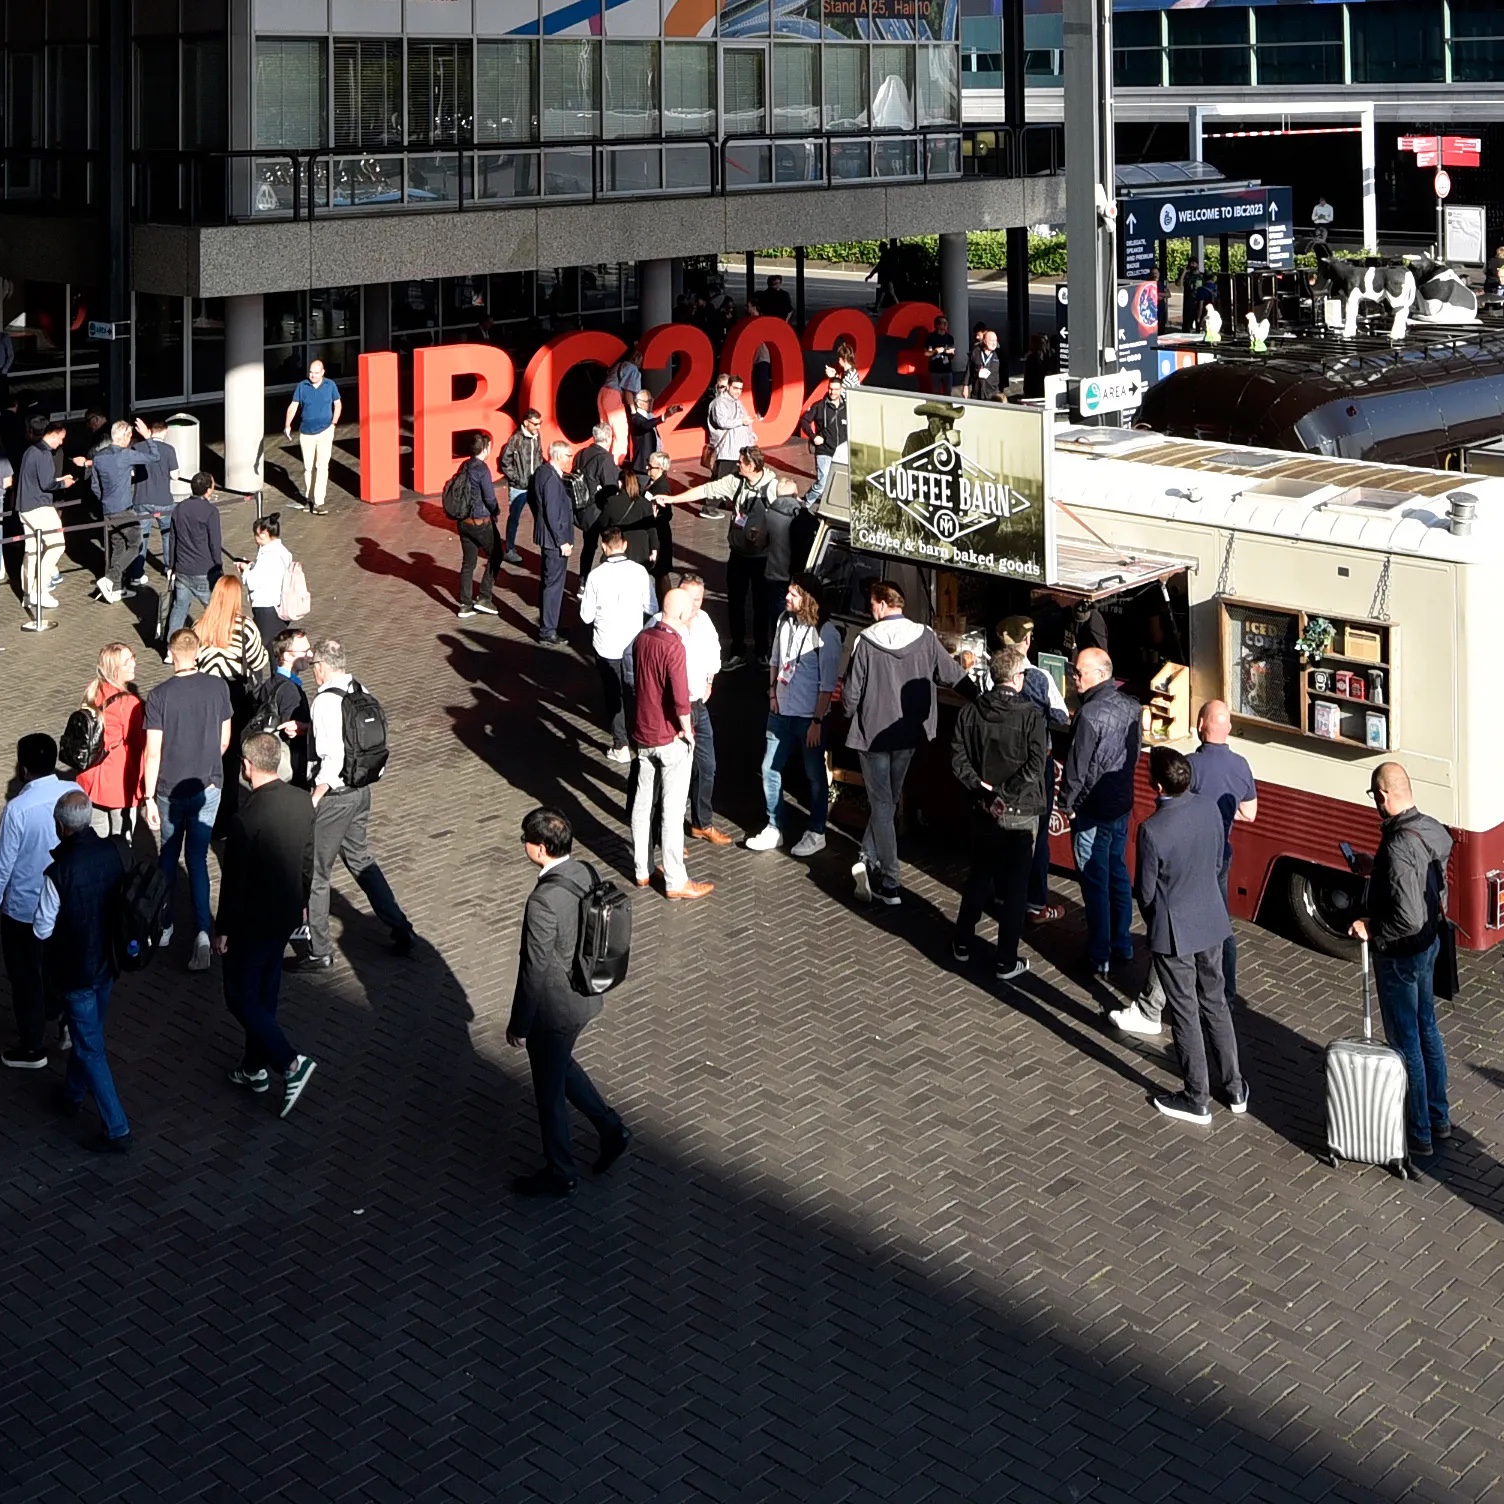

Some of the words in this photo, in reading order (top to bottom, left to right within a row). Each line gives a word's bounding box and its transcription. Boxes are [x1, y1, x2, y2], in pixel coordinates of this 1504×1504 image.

[893, 0, 916, 15] Hall
[918, 0, 931, 16] 10
[1178, 206, 1220, 223] WELCOME
[1221, 206, 1233, 219] TO
[1233, 204, 1263, 217] IBC2023
[1102, 386, 1127, 400] AREA
[885, 465, 953, 509] COFFEE
[959, 477, 1011, 518] BARN
[859, 529, 900, 549] Coffee
[904, 537, 915, 551] &
[919, 539, 949, 557] barn
[953, 546, 994, 567] baked
[998, 557, 1041, 576] goods
